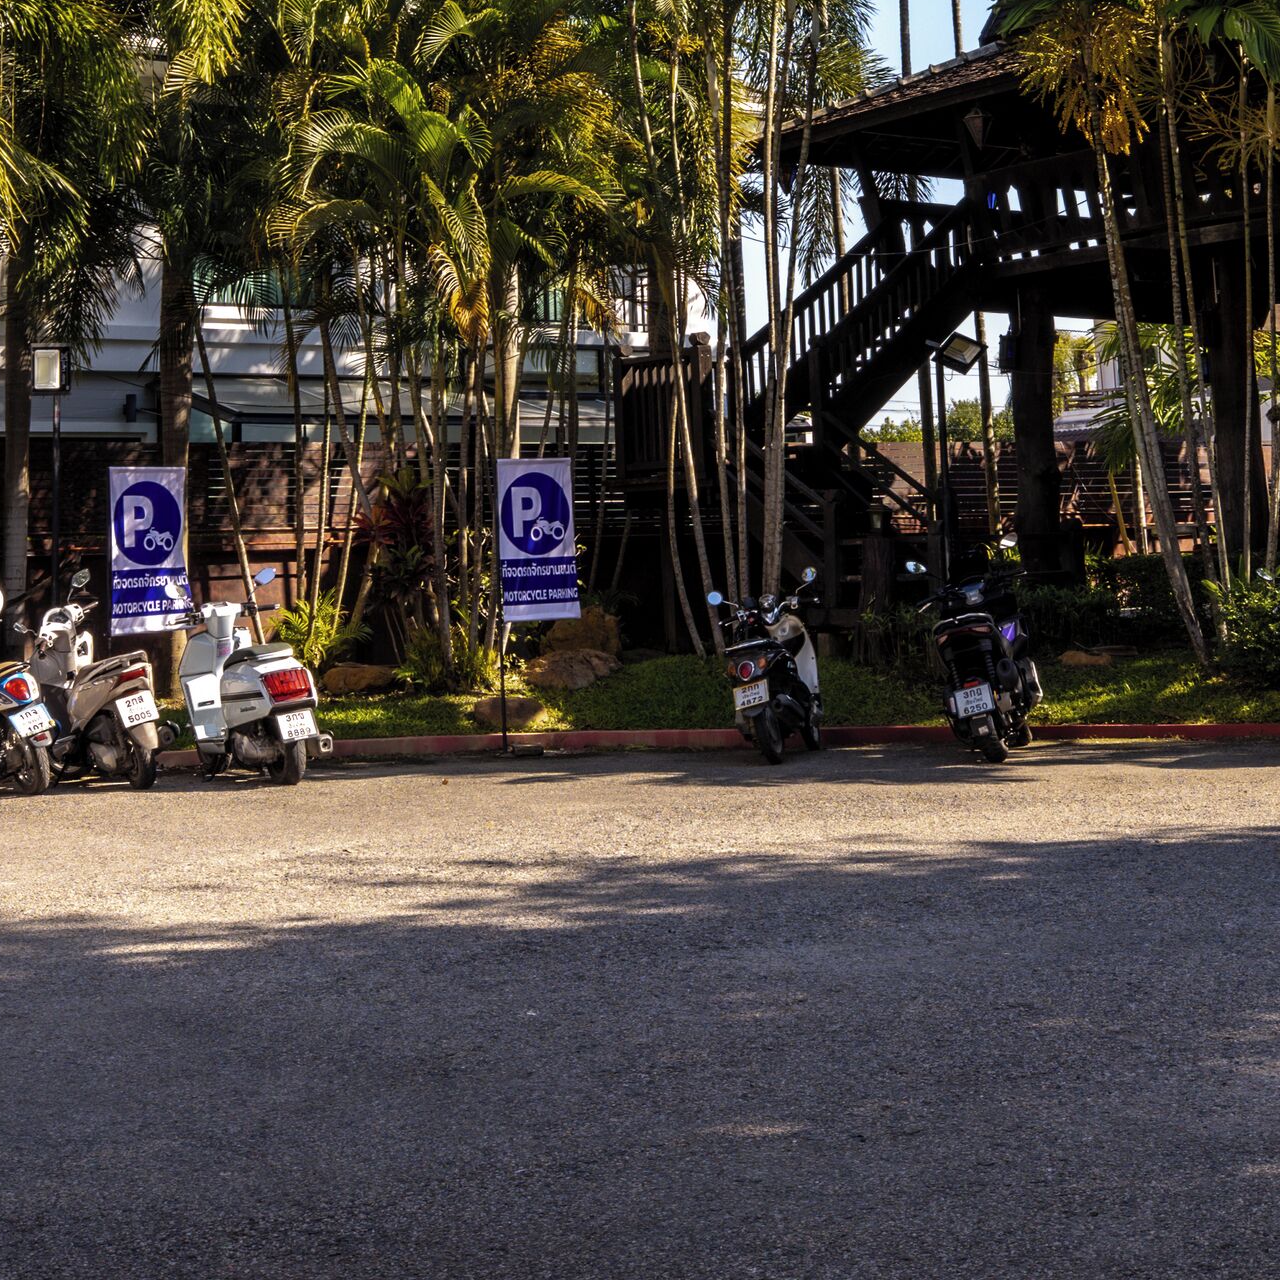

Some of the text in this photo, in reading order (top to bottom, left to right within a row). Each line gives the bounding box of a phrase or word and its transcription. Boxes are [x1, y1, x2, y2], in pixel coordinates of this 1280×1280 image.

[511, 486, 542, 538] P
[123, 495, 154, 548] P
[504, 587, 578, 602] MOTORCYCLE PARKING
[112, 599, 161, 615] MOTORCYCLE
[740, 695, 764, 707] 4872
[963, 702, 988, 715] 6250
[128, 710, 153, 723] 5005
